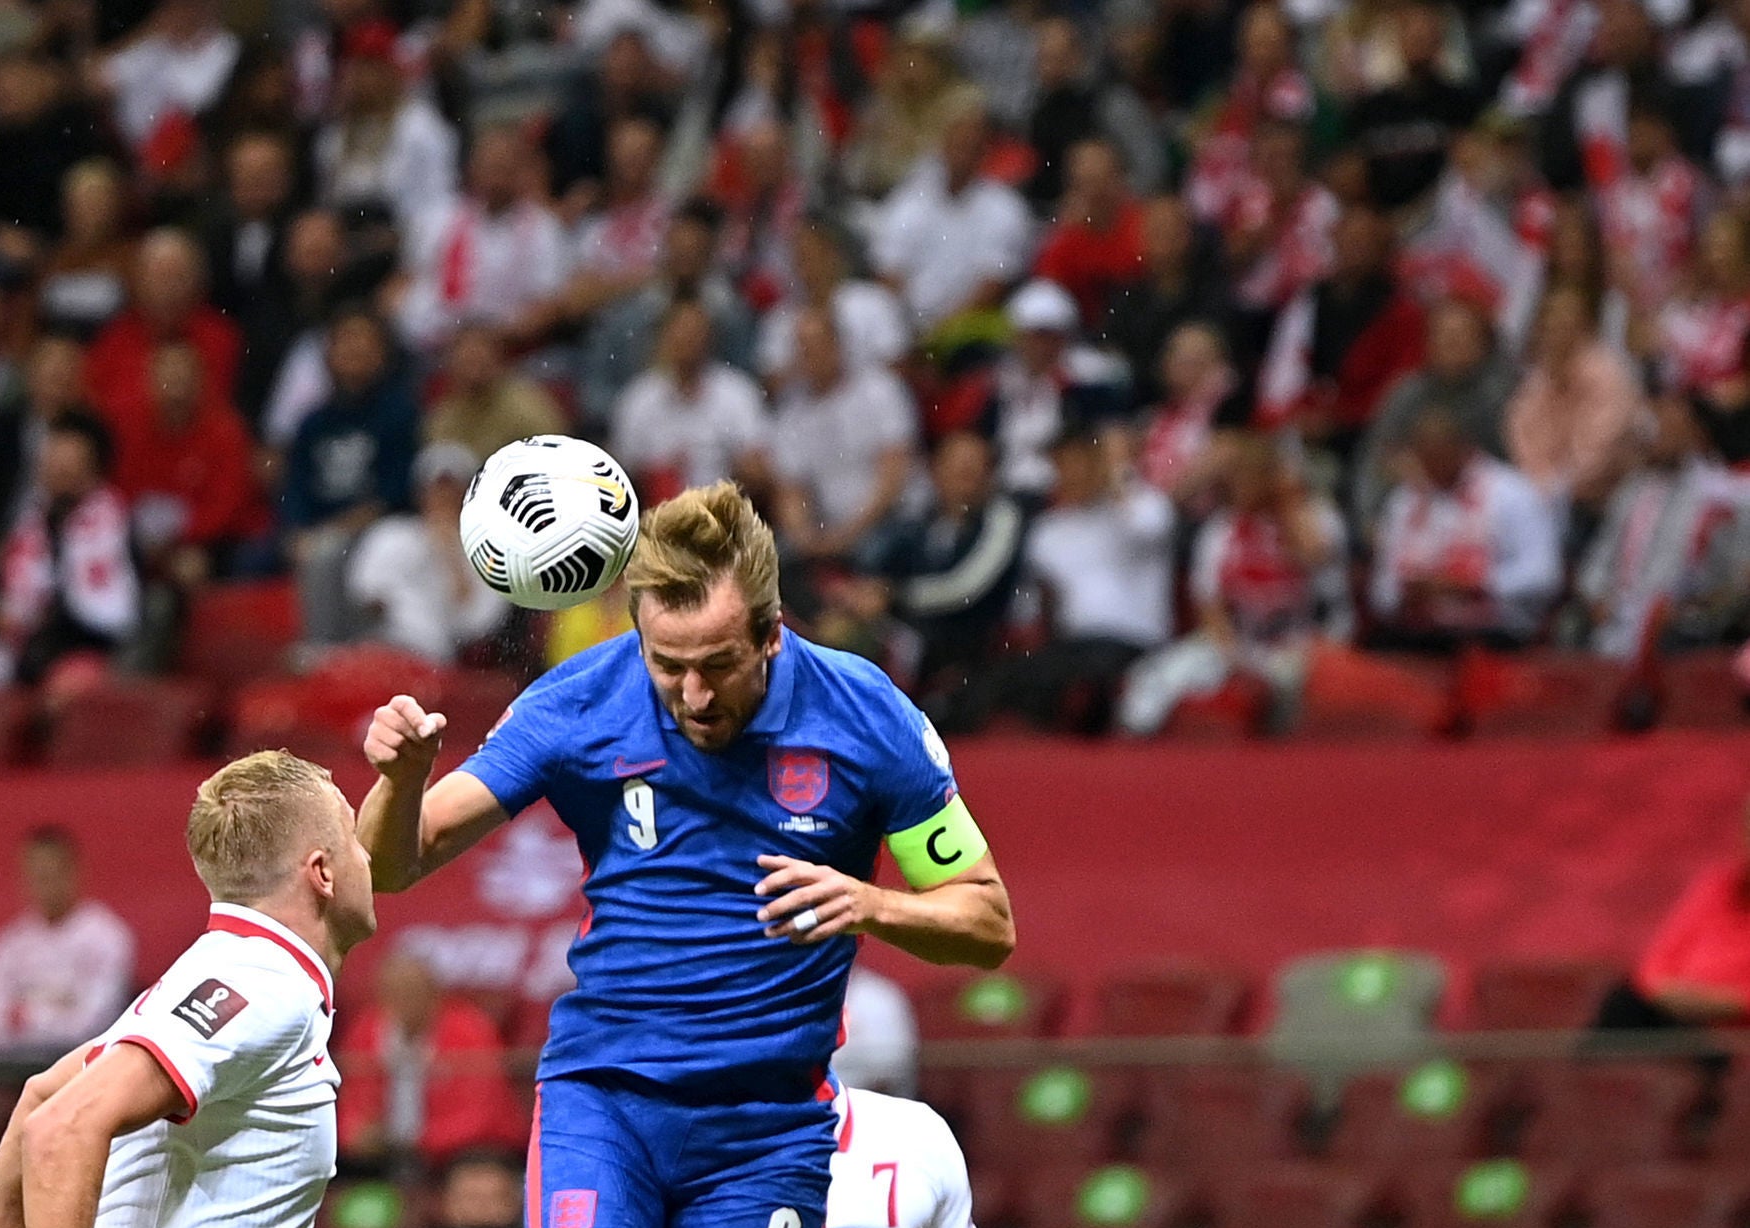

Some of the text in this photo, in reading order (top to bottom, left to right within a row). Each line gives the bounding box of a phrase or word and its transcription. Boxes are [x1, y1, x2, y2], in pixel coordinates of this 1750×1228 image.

[623, 778, 659, 850] 9
[926, 826, 963, 866] C
[872, 1161, 899, 1228] 7
